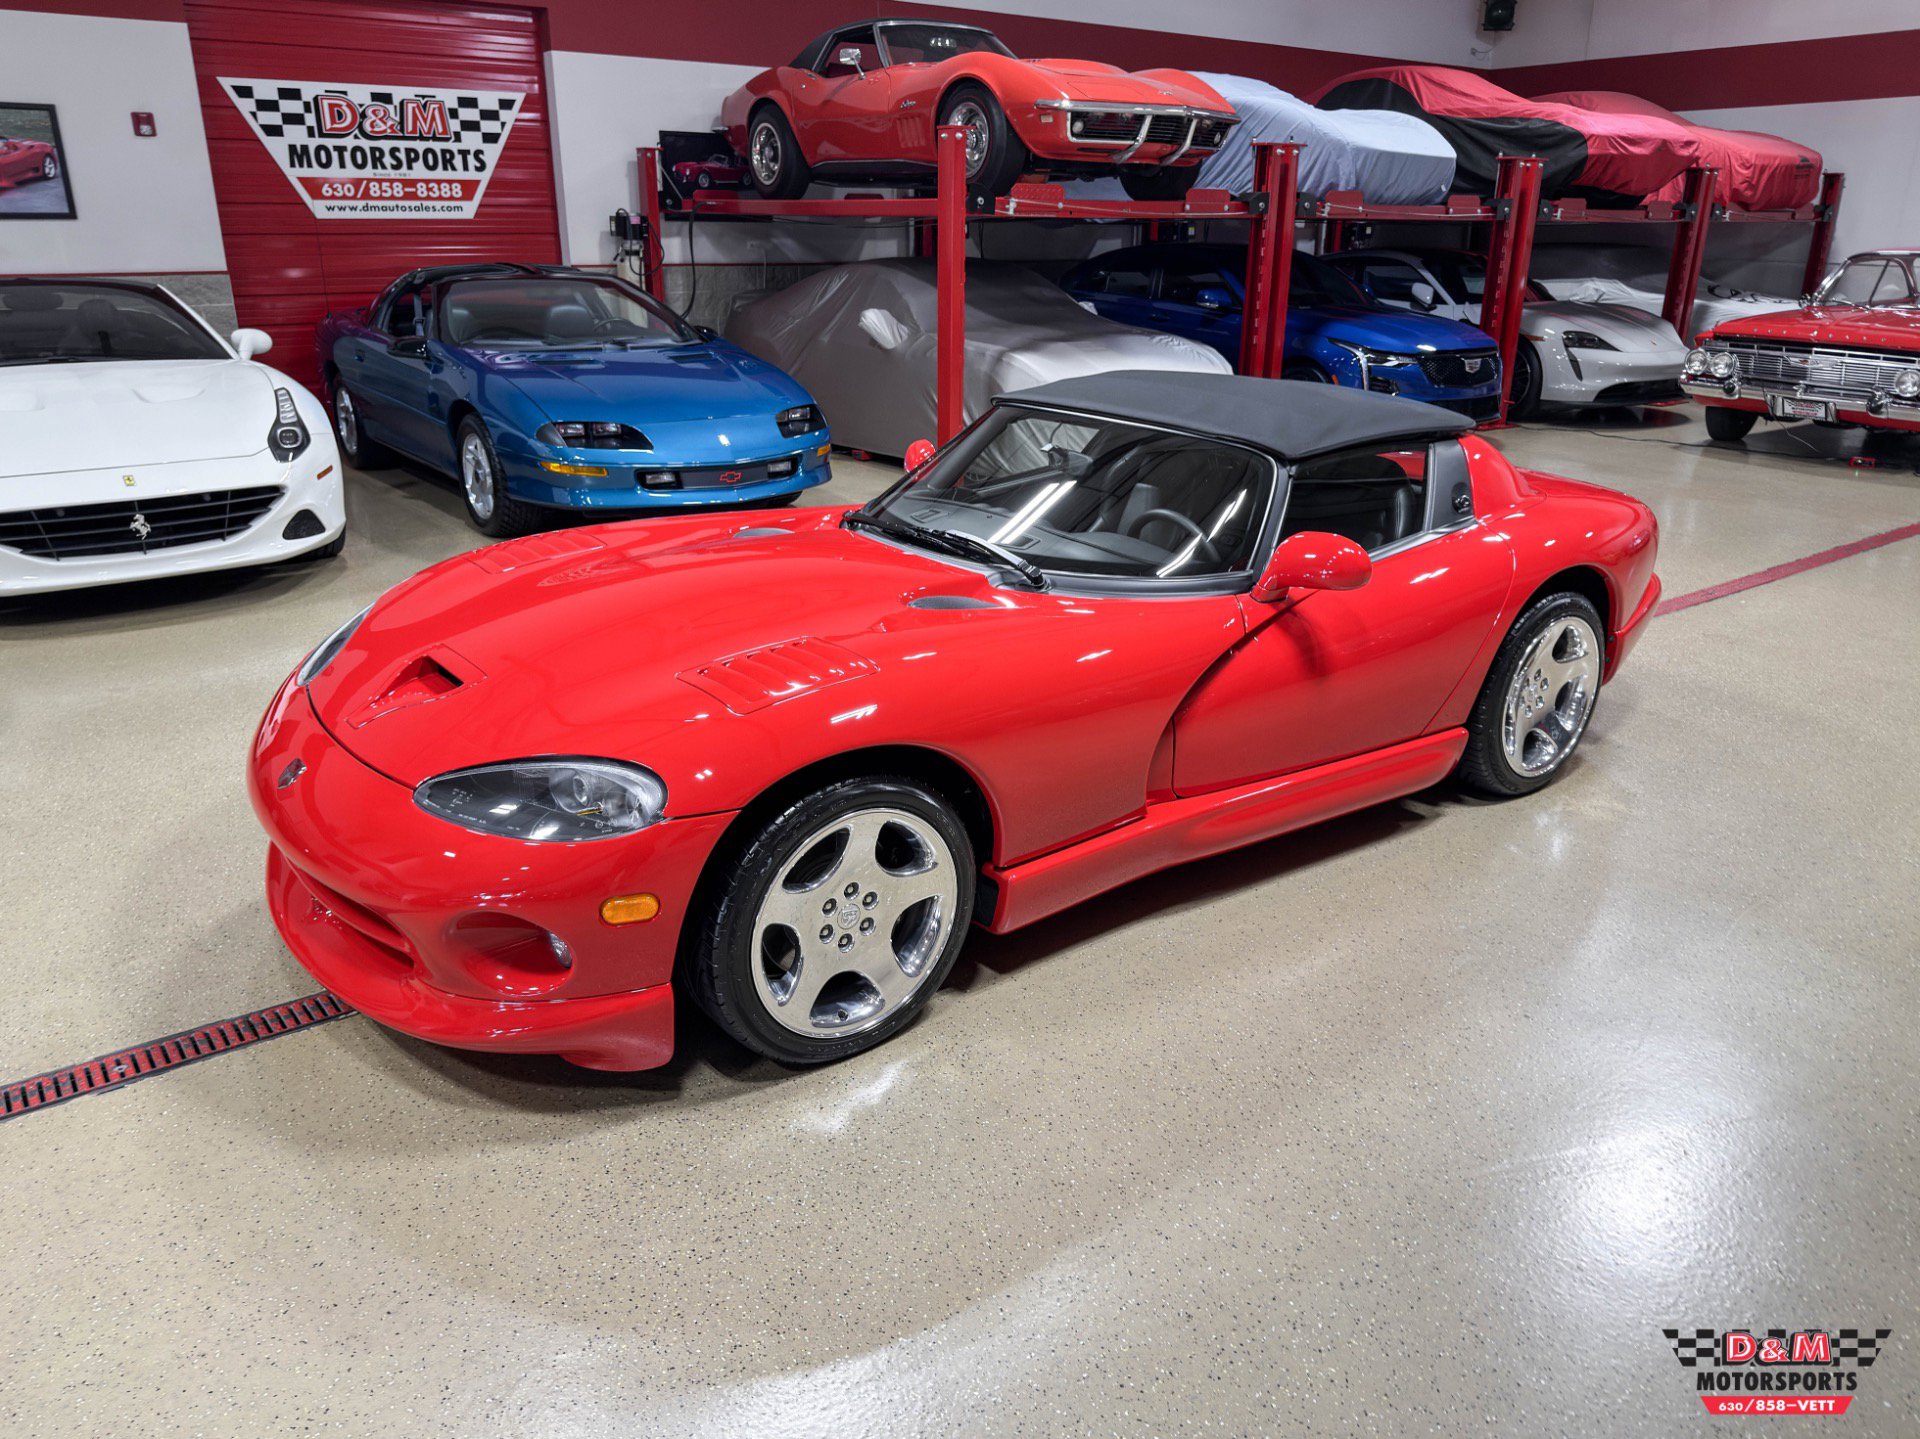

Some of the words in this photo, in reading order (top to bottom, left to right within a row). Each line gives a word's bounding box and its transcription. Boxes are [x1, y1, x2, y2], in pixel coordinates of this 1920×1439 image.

[314, 95, 452, 142] D&M
[288, 144, 487, 172] MOTORSPORTS
[324, 203, 464, 214] www.dmautosales.com
